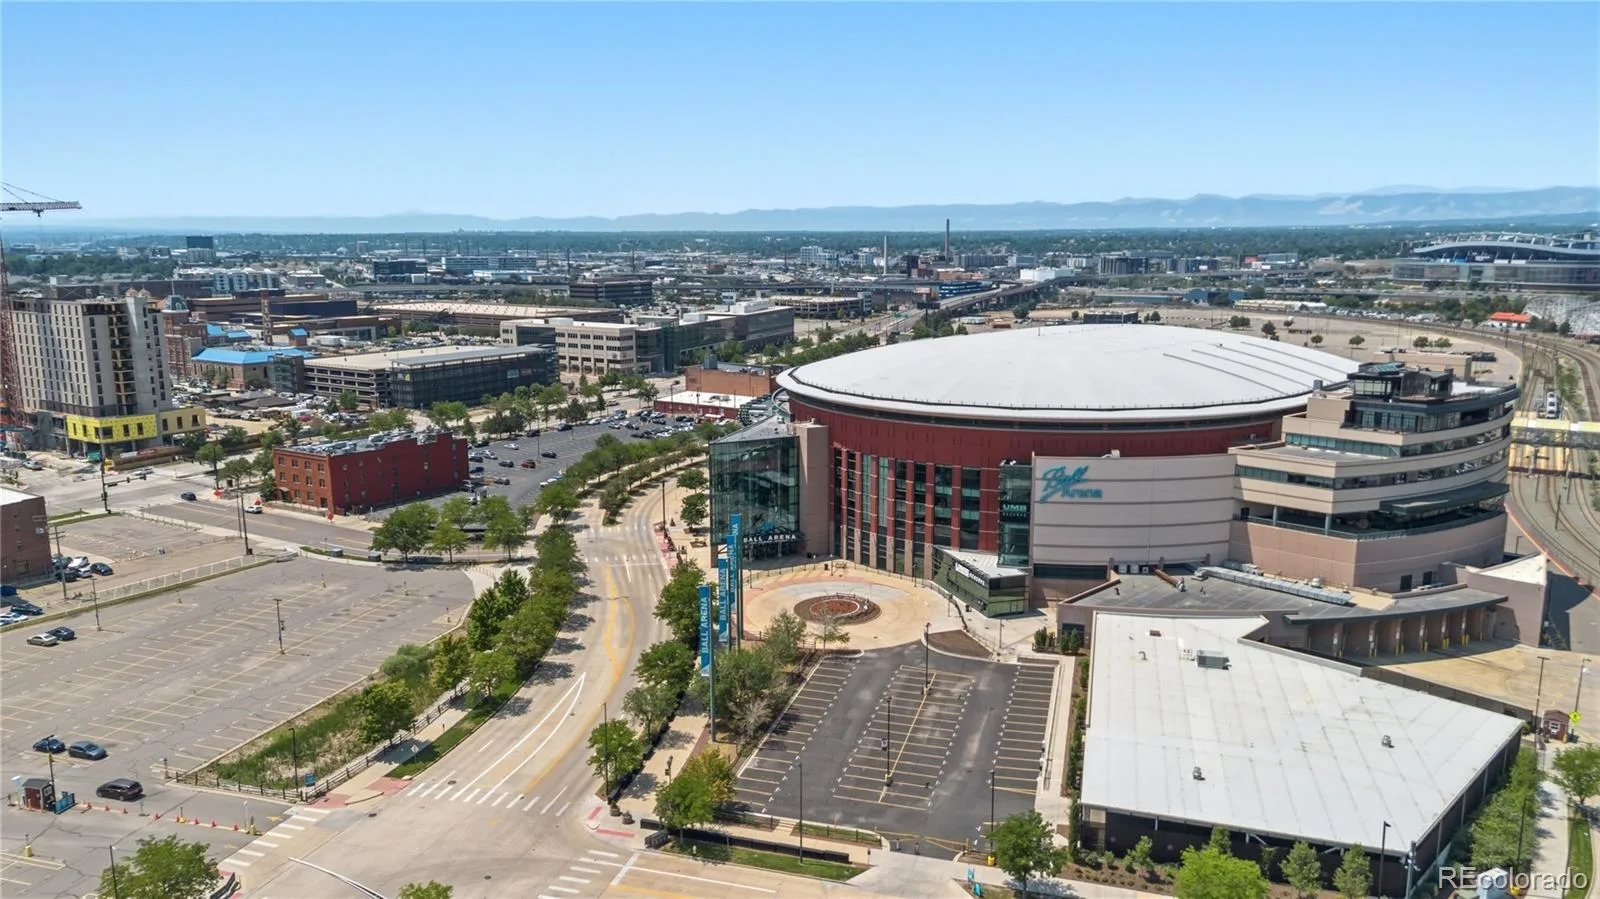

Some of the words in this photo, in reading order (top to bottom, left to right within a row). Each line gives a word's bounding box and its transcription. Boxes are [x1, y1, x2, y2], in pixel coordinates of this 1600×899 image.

[1039, 464, 1090, 504] Ball
[1002, 504, 1027, 512] UMB
[700, 596, 709, 629] ARENA
[701, 631, 709, 654] BALL
